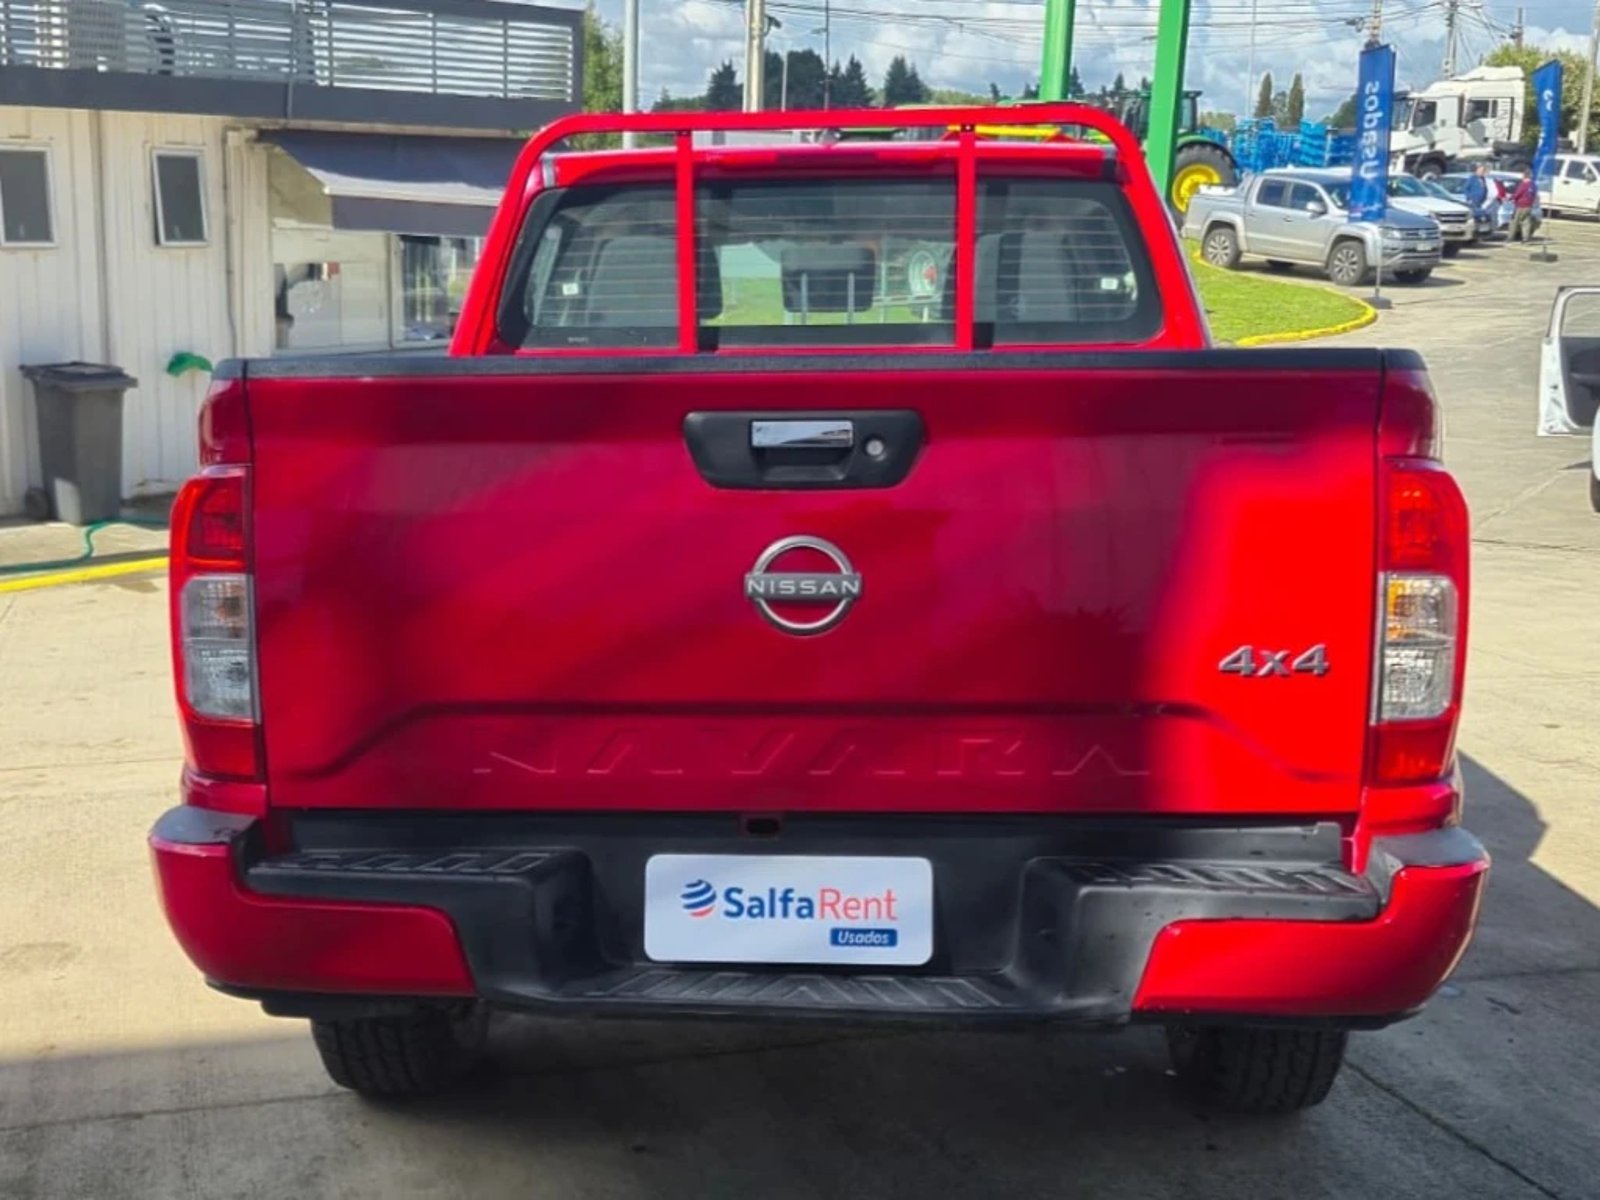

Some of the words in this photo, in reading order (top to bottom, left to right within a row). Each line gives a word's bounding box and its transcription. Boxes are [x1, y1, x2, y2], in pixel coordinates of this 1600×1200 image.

[747, 580, 859, 594] NISSAN
[1218, 643, 1329, 677] 4x4
[473, 727, 1151, 776] NAVARA
[723, 886, 898, 921] SalfaRent
[838, 929, 889, 945] Usados
